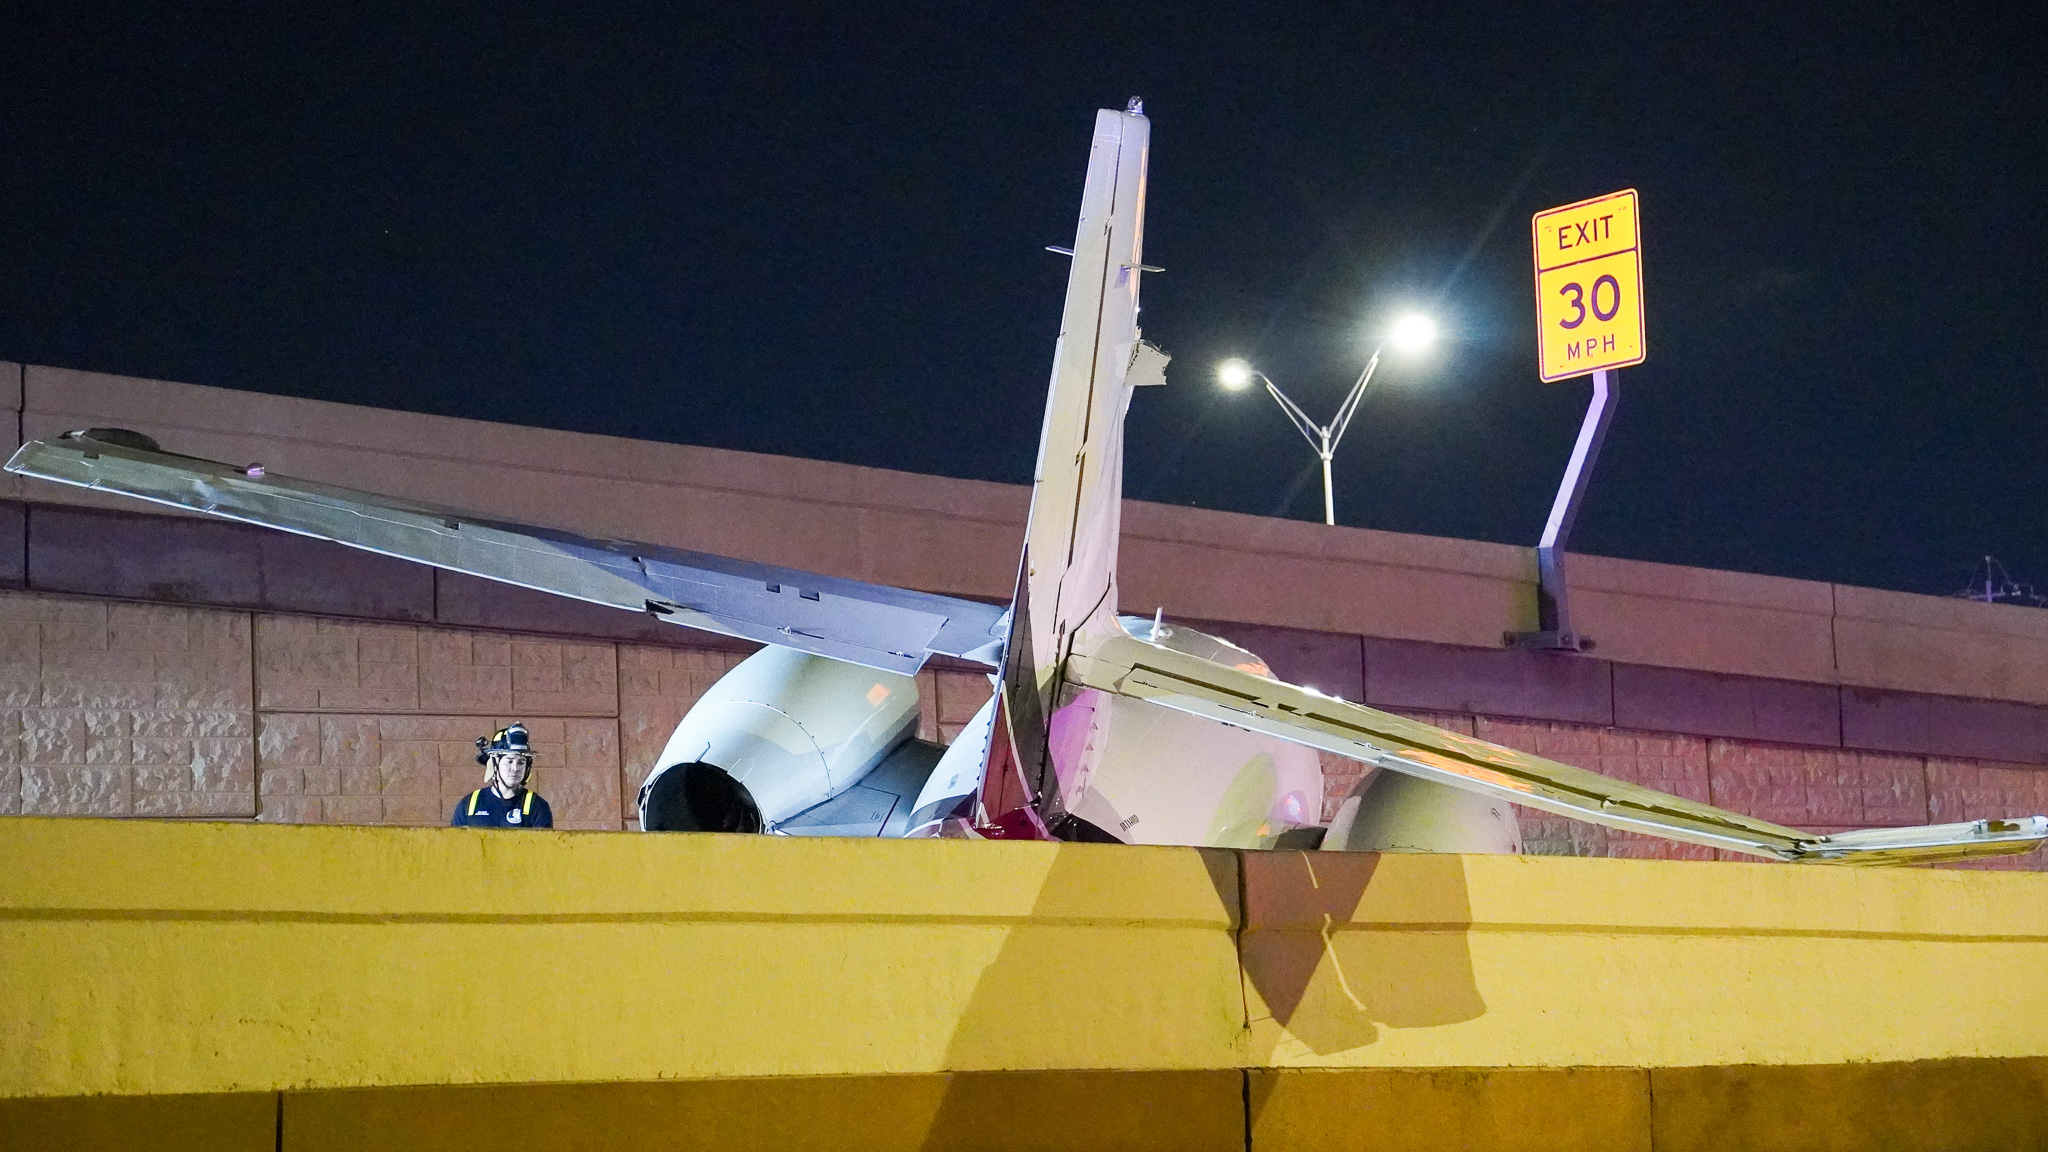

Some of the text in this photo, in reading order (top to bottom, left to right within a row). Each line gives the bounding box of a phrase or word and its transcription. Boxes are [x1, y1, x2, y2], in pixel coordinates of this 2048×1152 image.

[1558, 214, 1613, 250] EXIT
[1559, 274, 1621, 329] 30
[1567, 333, 1615, 361] MPH
